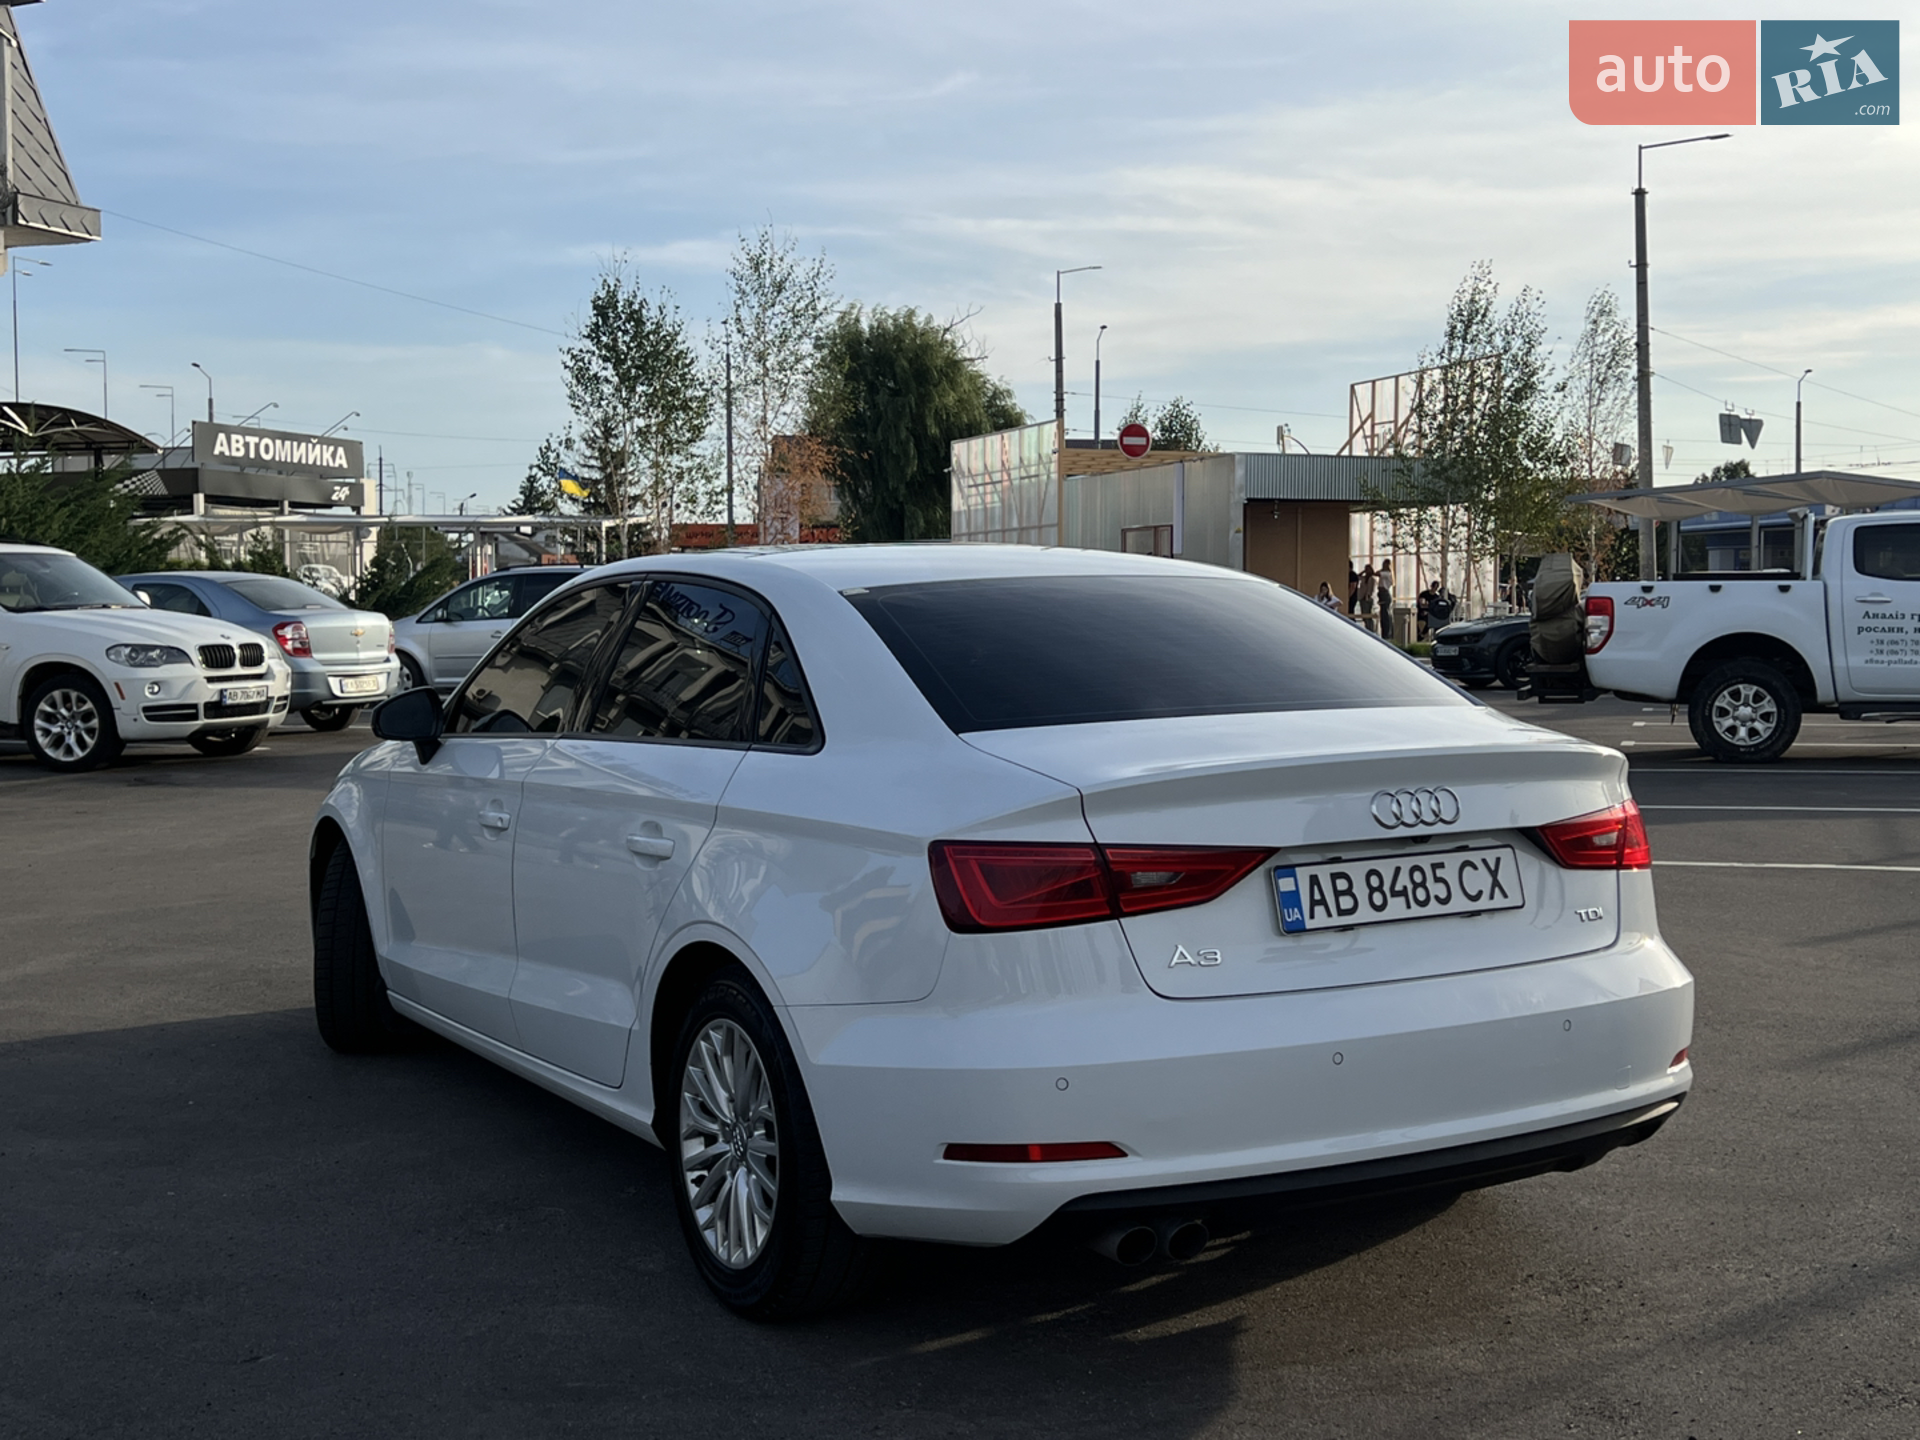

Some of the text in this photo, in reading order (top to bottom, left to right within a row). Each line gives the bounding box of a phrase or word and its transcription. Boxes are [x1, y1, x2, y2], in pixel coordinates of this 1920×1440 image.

[213, 432, 349, 469] АВТОМИЙКА
[1862, 610, 1906, 620] Аналіз
[1857, 626, 1909, 636] рослин,
[1309, 856, 1509, 920] AB 8485 CX
[1283, 907, 1302, 923] UA
[1574, 907, 1604, 923] TDI
[1168, 944, 1222, 969] A3
